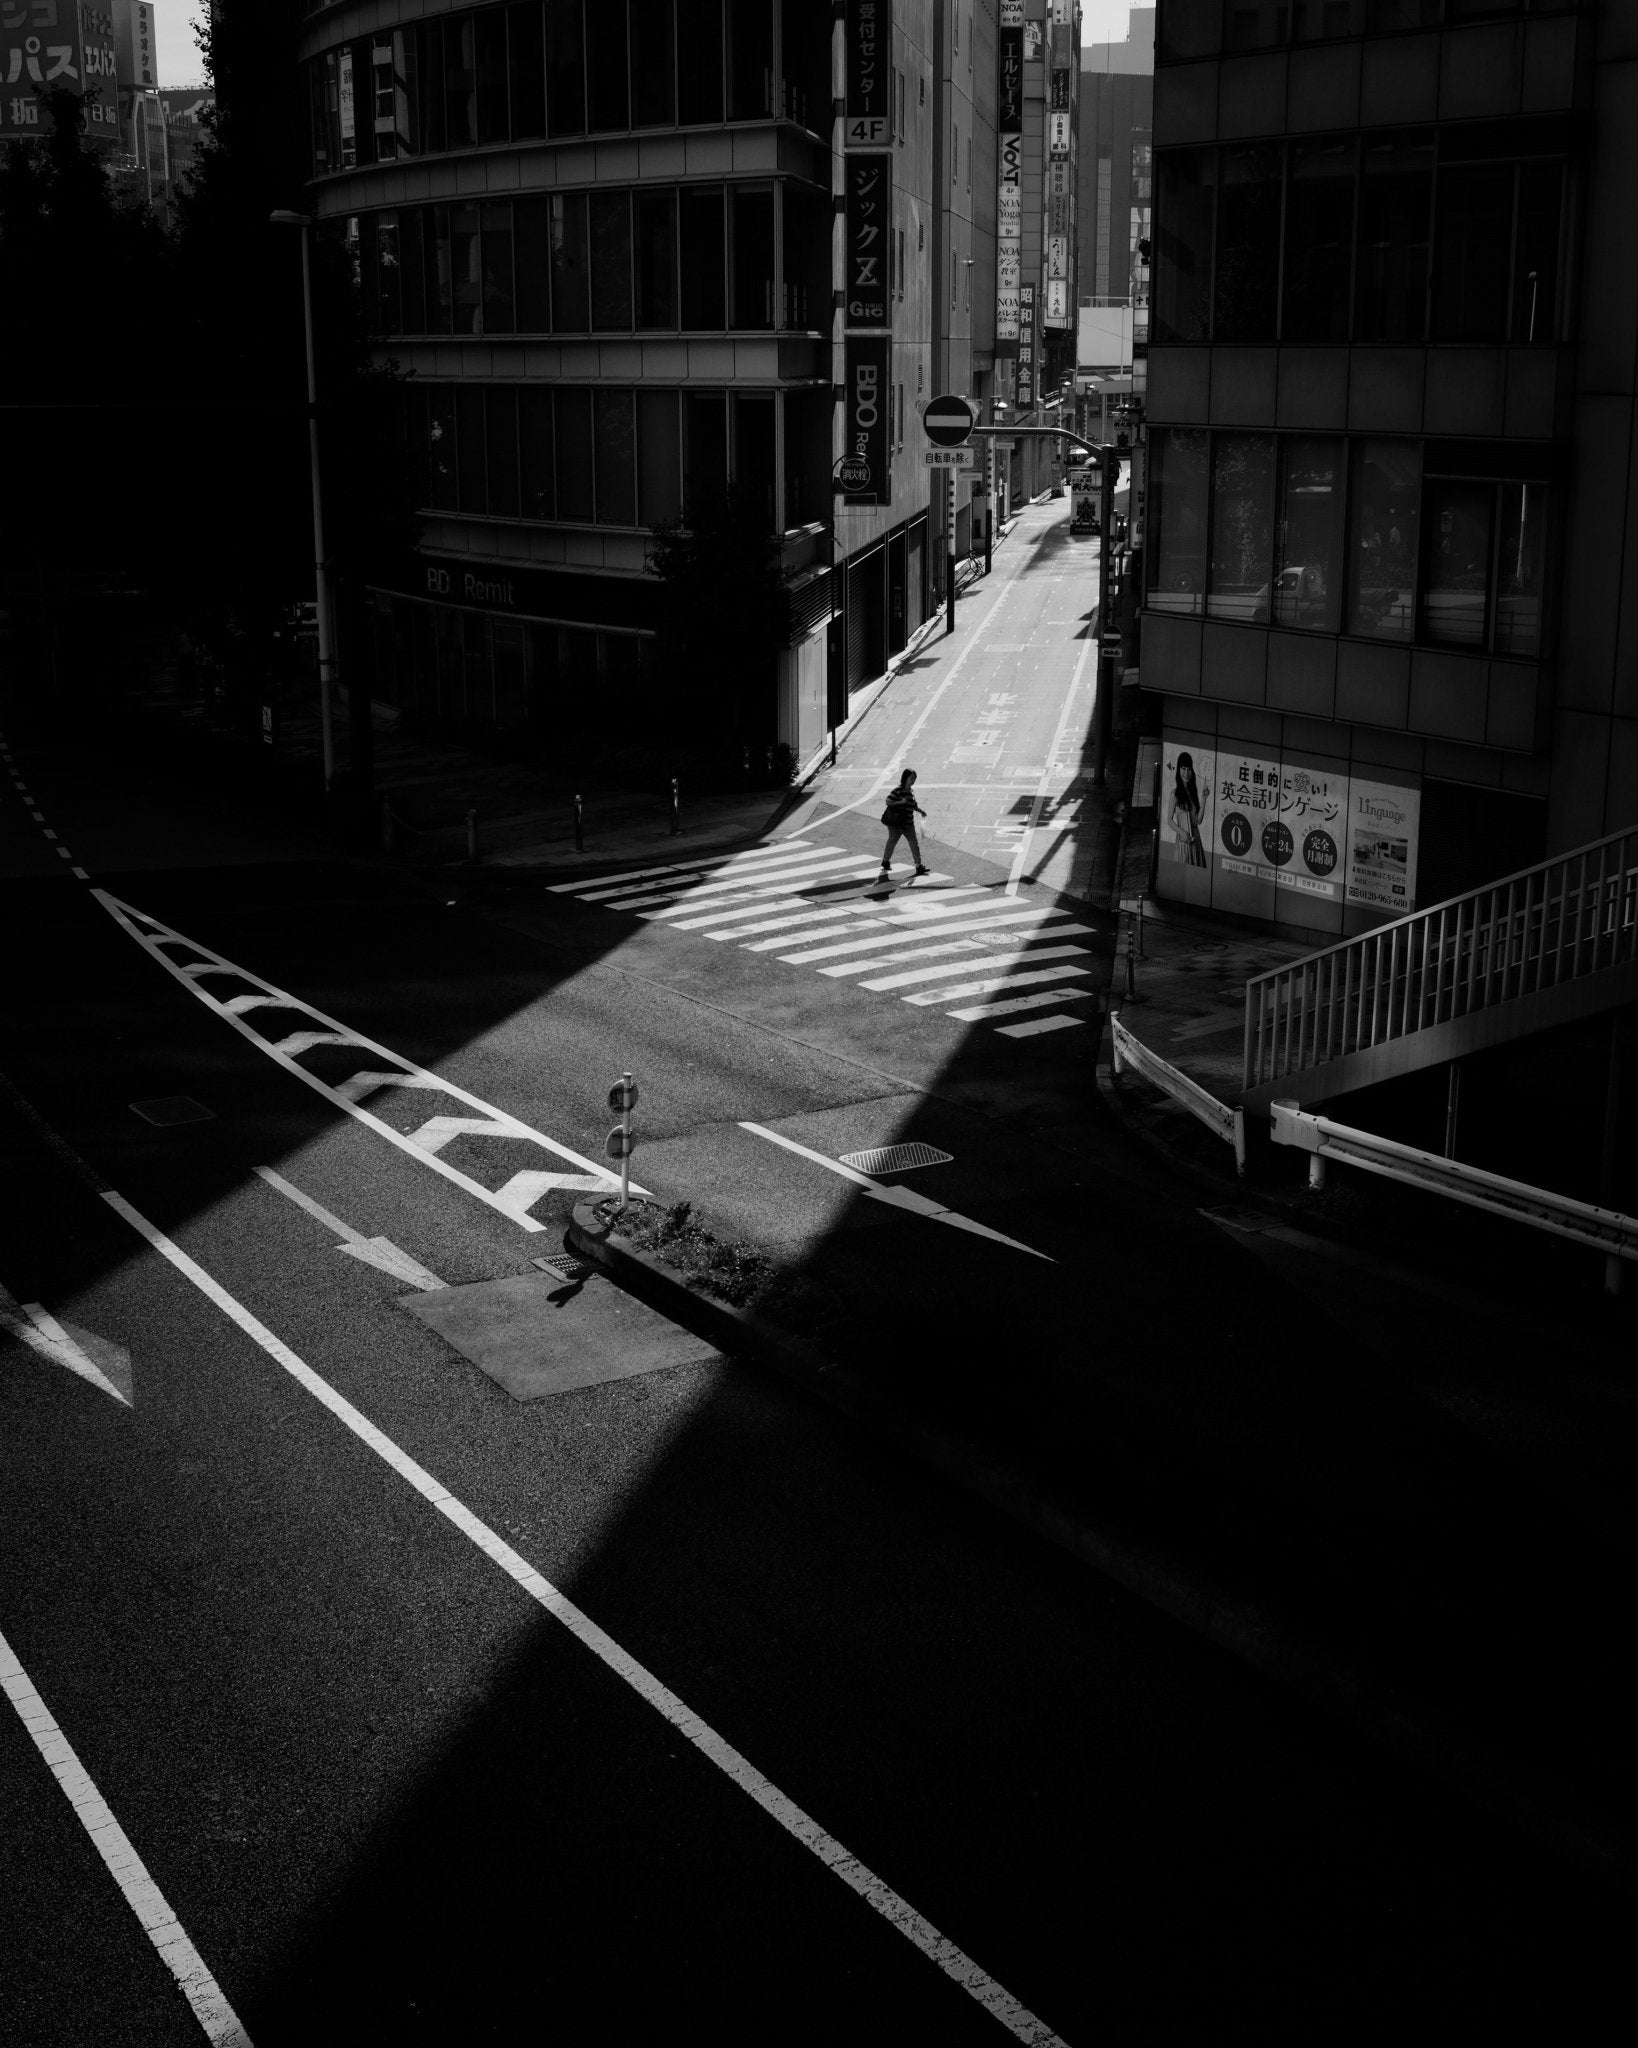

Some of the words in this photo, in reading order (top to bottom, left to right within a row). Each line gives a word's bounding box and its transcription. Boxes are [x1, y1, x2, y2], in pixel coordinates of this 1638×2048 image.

[1001, 4, 1024, 12] NOA
[0, 36, 79, 83] パス
[85, 41, 116, 77] エスパス
[1003, 42, 1019, 121] エルセーヌ
[851, 121, 883, 139] 4F
[999, 199, 1020, 208] NOA
[999, 209, 1020, 219] Yoga
[999, 247, 1020, 255] NOA
[999, 258, 1020, 266] ダンス
[997, 298, 1019, 307] NOA
[856, 365, 878, 428] BDO
[926, 452, 969, 464] 自転車を除く
[842, 468, 867, 480] 消火栓
[464, 573, 515, 606] Remit
[1221, 781, 1339, 821] 英会話リンゲージ
[1359, 797, 1407, 824] Linguage
[1311, 836, 1330, 852] 完全
